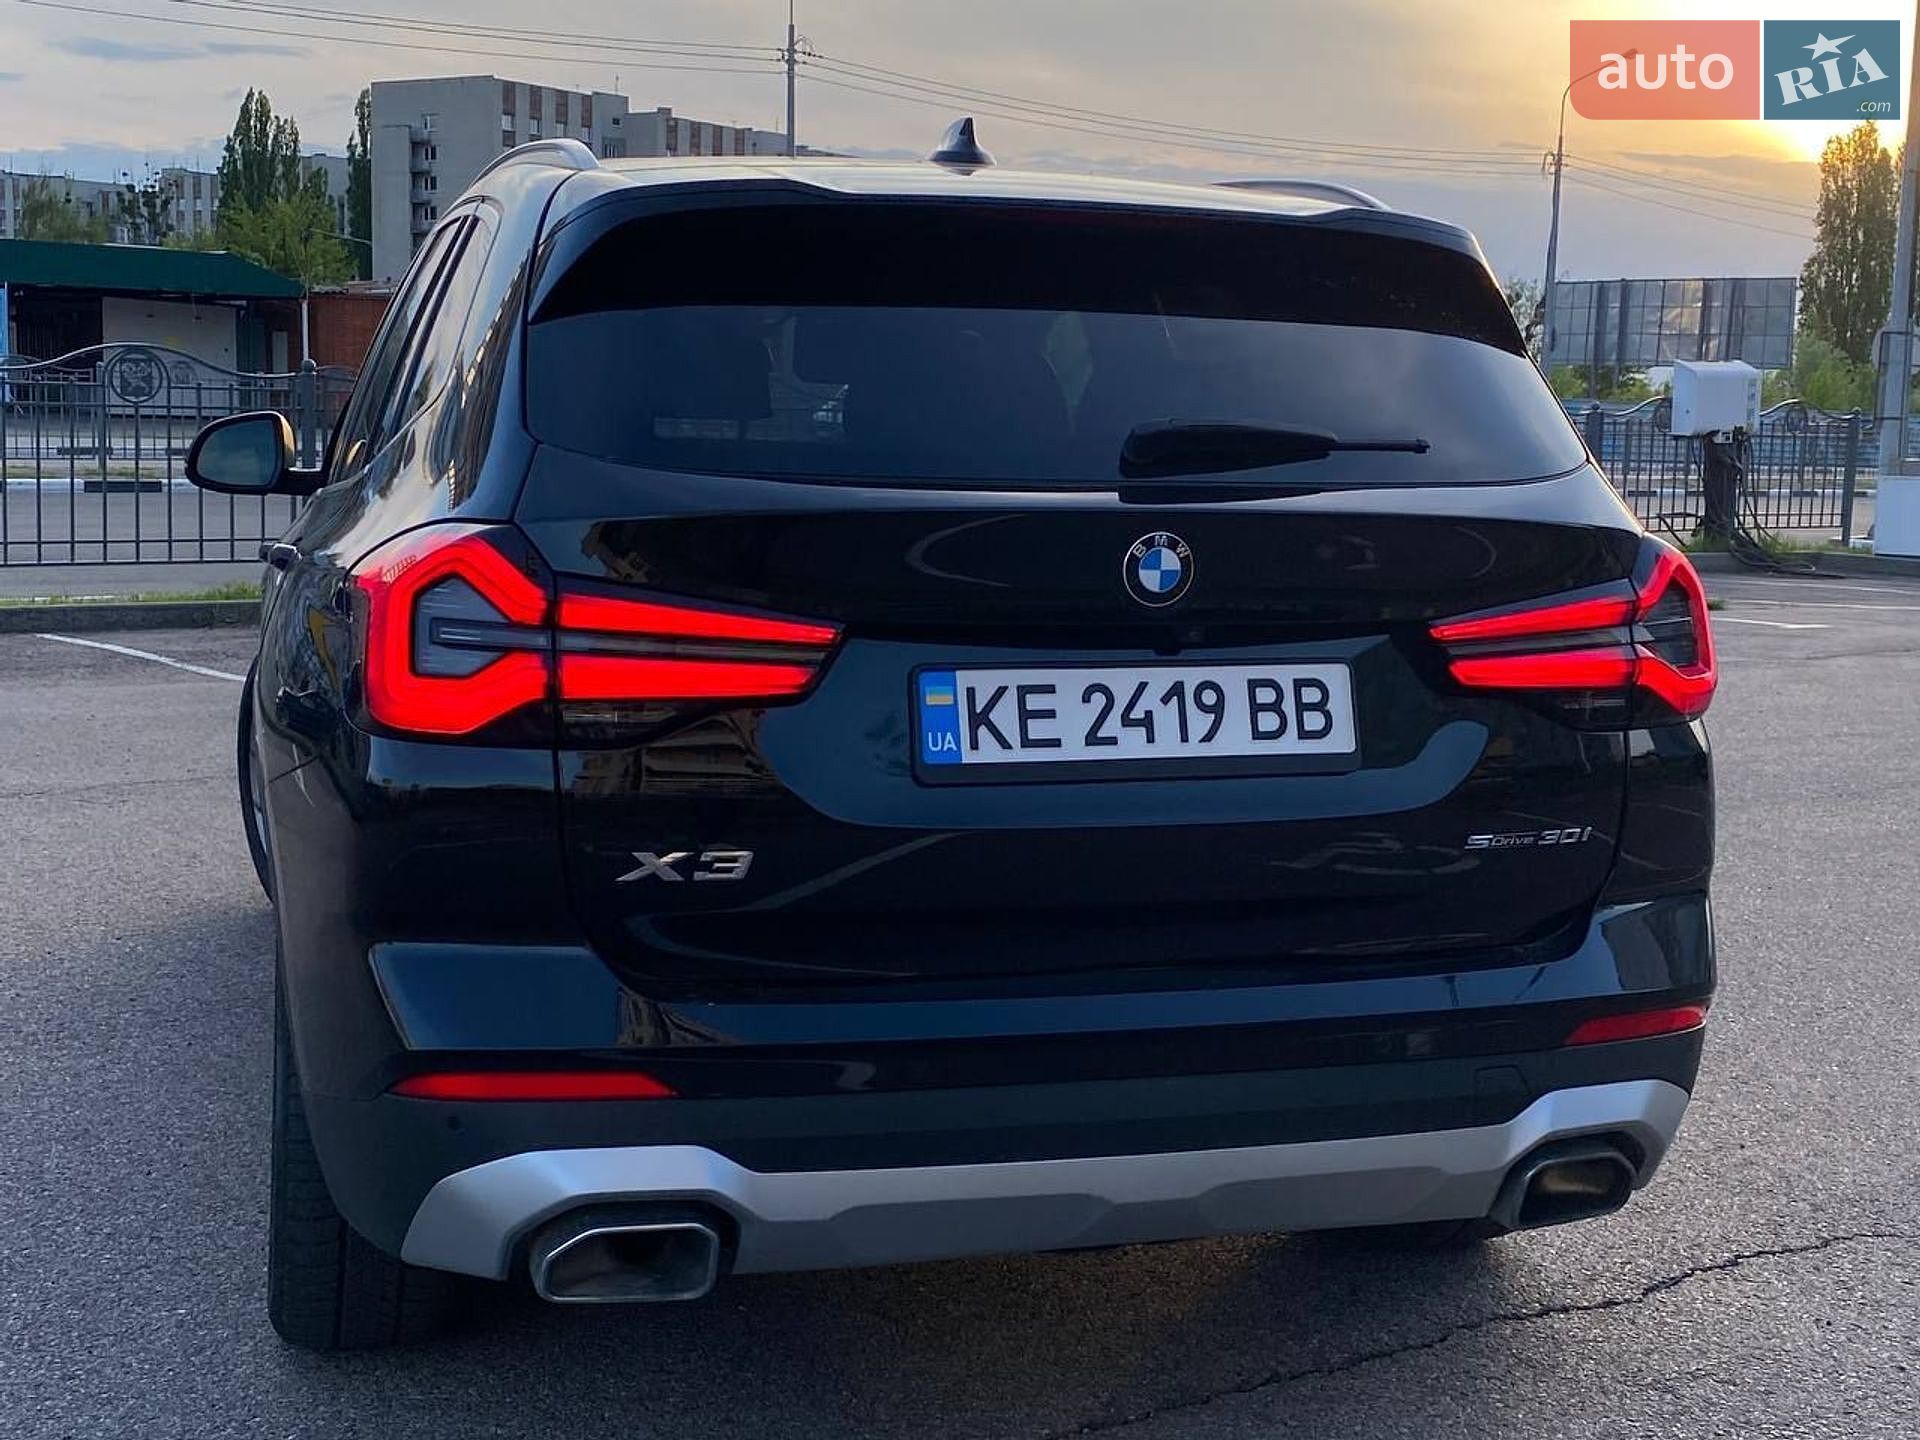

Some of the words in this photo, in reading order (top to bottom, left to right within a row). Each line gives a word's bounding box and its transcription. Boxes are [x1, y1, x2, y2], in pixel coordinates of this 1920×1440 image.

[1132, 535, 1190, 558] BMW
[966, 684, 1062, 750] KE
[1081, 680, 1225, 747] 2419
[1247, 678, 1334, 741] BB
[928, 732, 957, 751] UA
[614, 850, 754, 881] X3
